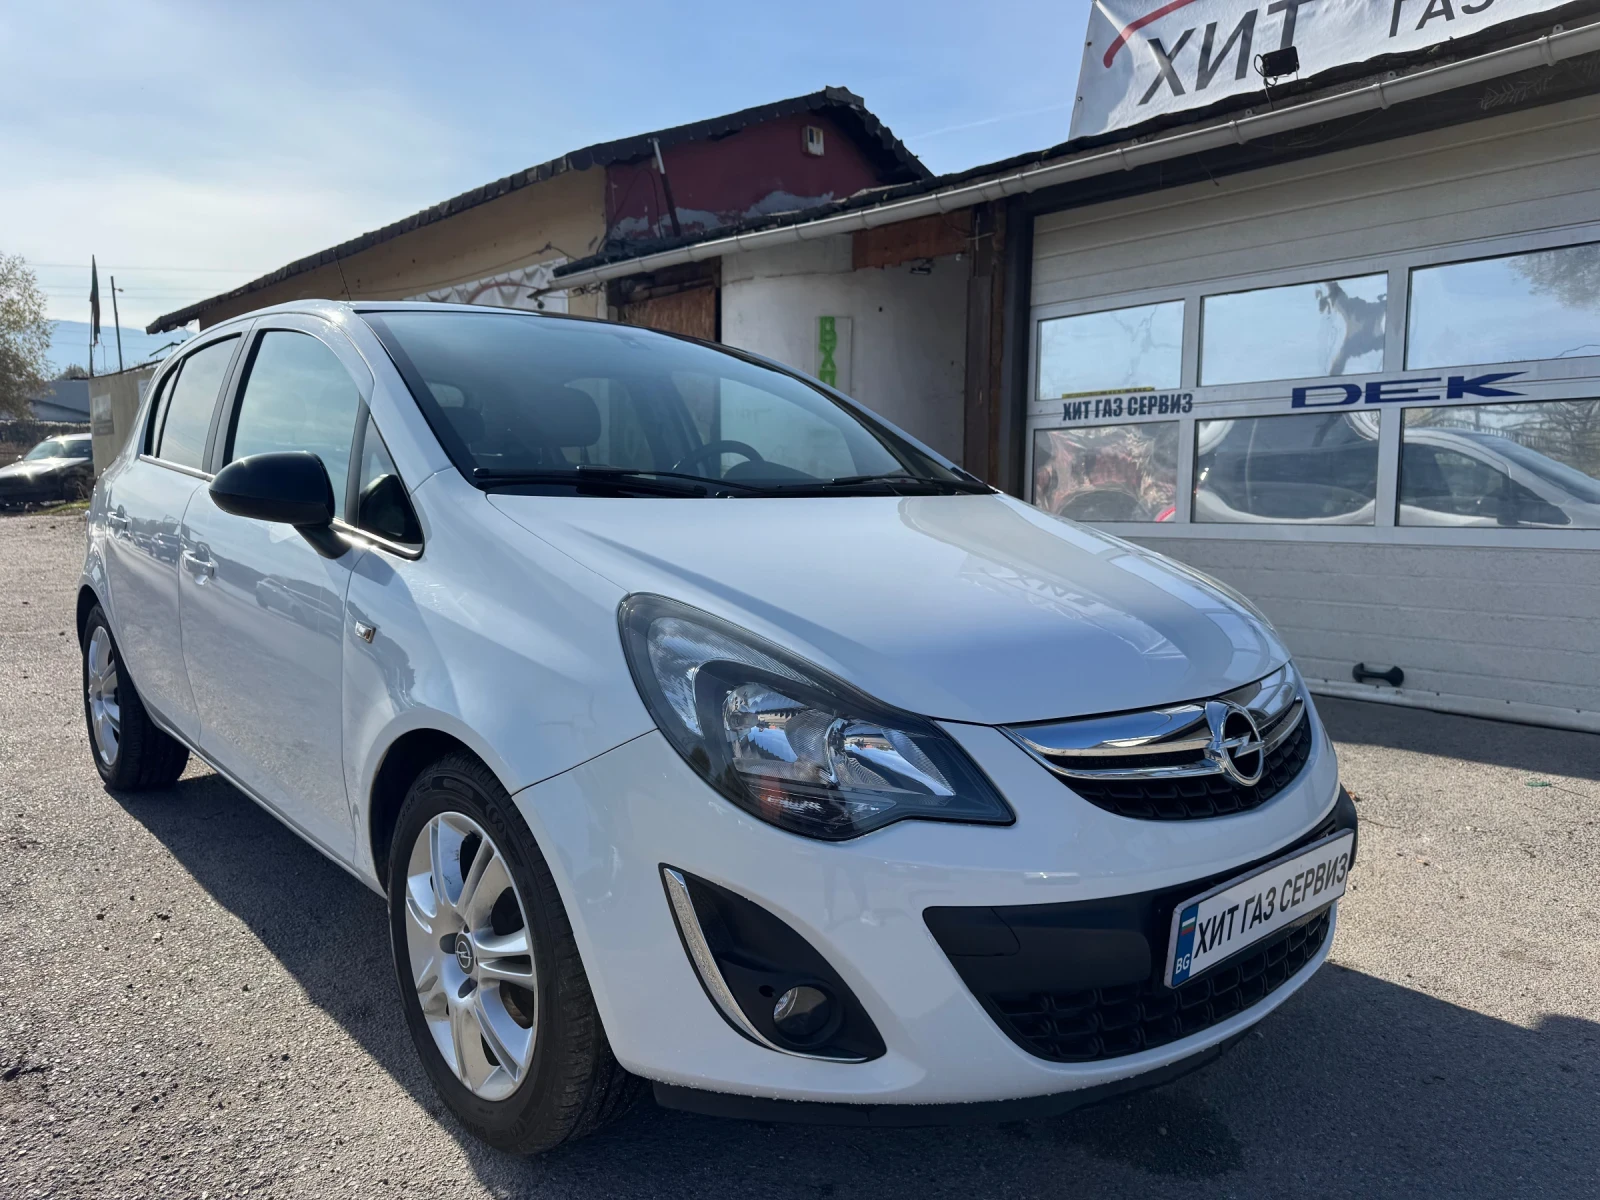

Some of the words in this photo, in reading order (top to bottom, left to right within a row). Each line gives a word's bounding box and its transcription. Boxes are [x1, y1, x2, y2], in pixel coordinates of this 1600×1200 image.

[1136, 0, 1302, 106] ХИТ
[1062, 400, 1091, 421] ХИТ
[1095, 397, 1123, 418] ГАЗ
[1127, 393, 1193, 416] СЕРВИЗ
[1291, 371, 1530, 408] DEK
[1193, 904, 1239, 959] ХИТ
[1240, 886, 1276, 934] ГАЗ
[1279, 852, 1349, 912] СЕРВИЗ
[1175, 953, 1190, 974] BG
